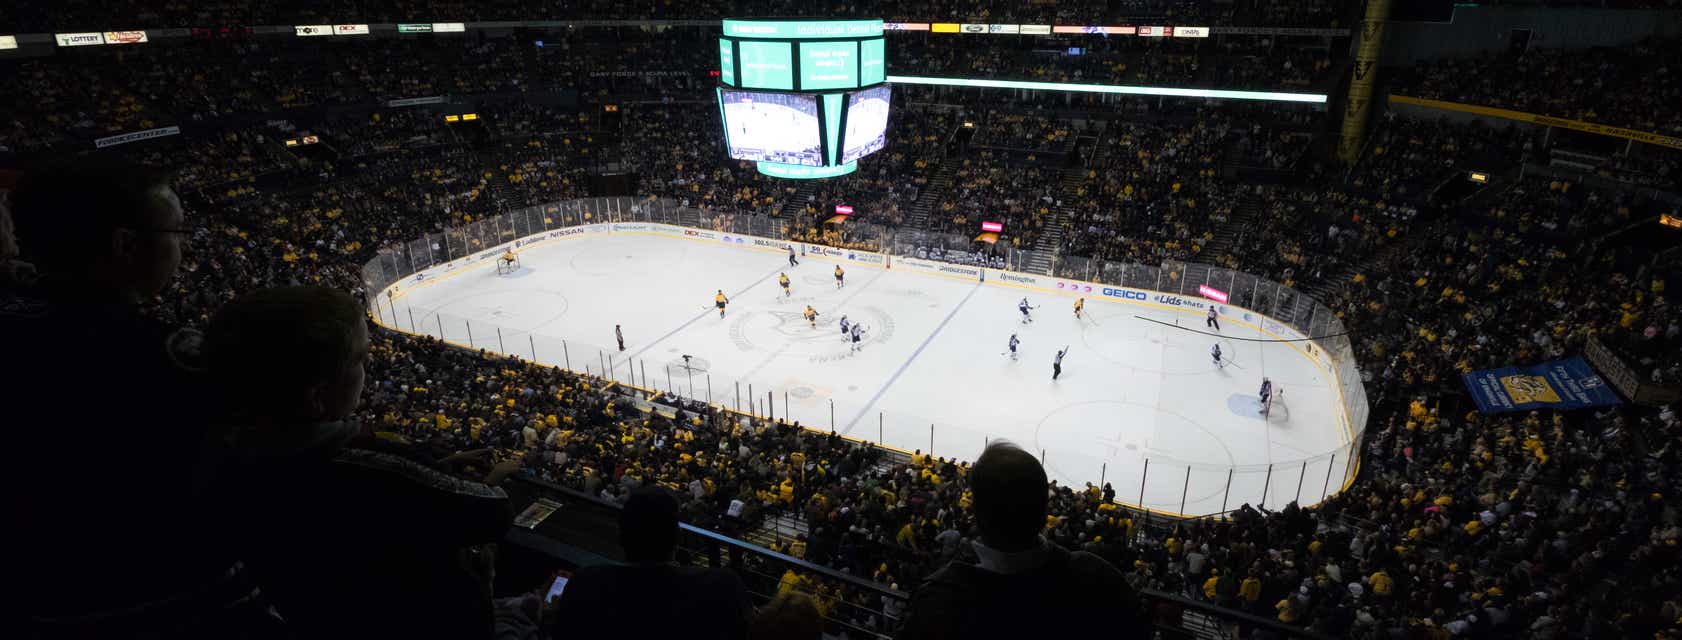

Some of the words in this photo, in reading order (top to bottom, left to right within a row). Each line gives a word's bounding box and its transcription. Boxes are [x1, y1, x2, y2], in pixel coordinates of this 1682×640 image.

[71, 35, 98, 43] LOTTERY
[551, 228, 584, 238] NISSAN
[1103, 287, 1147, 301] GEICO
